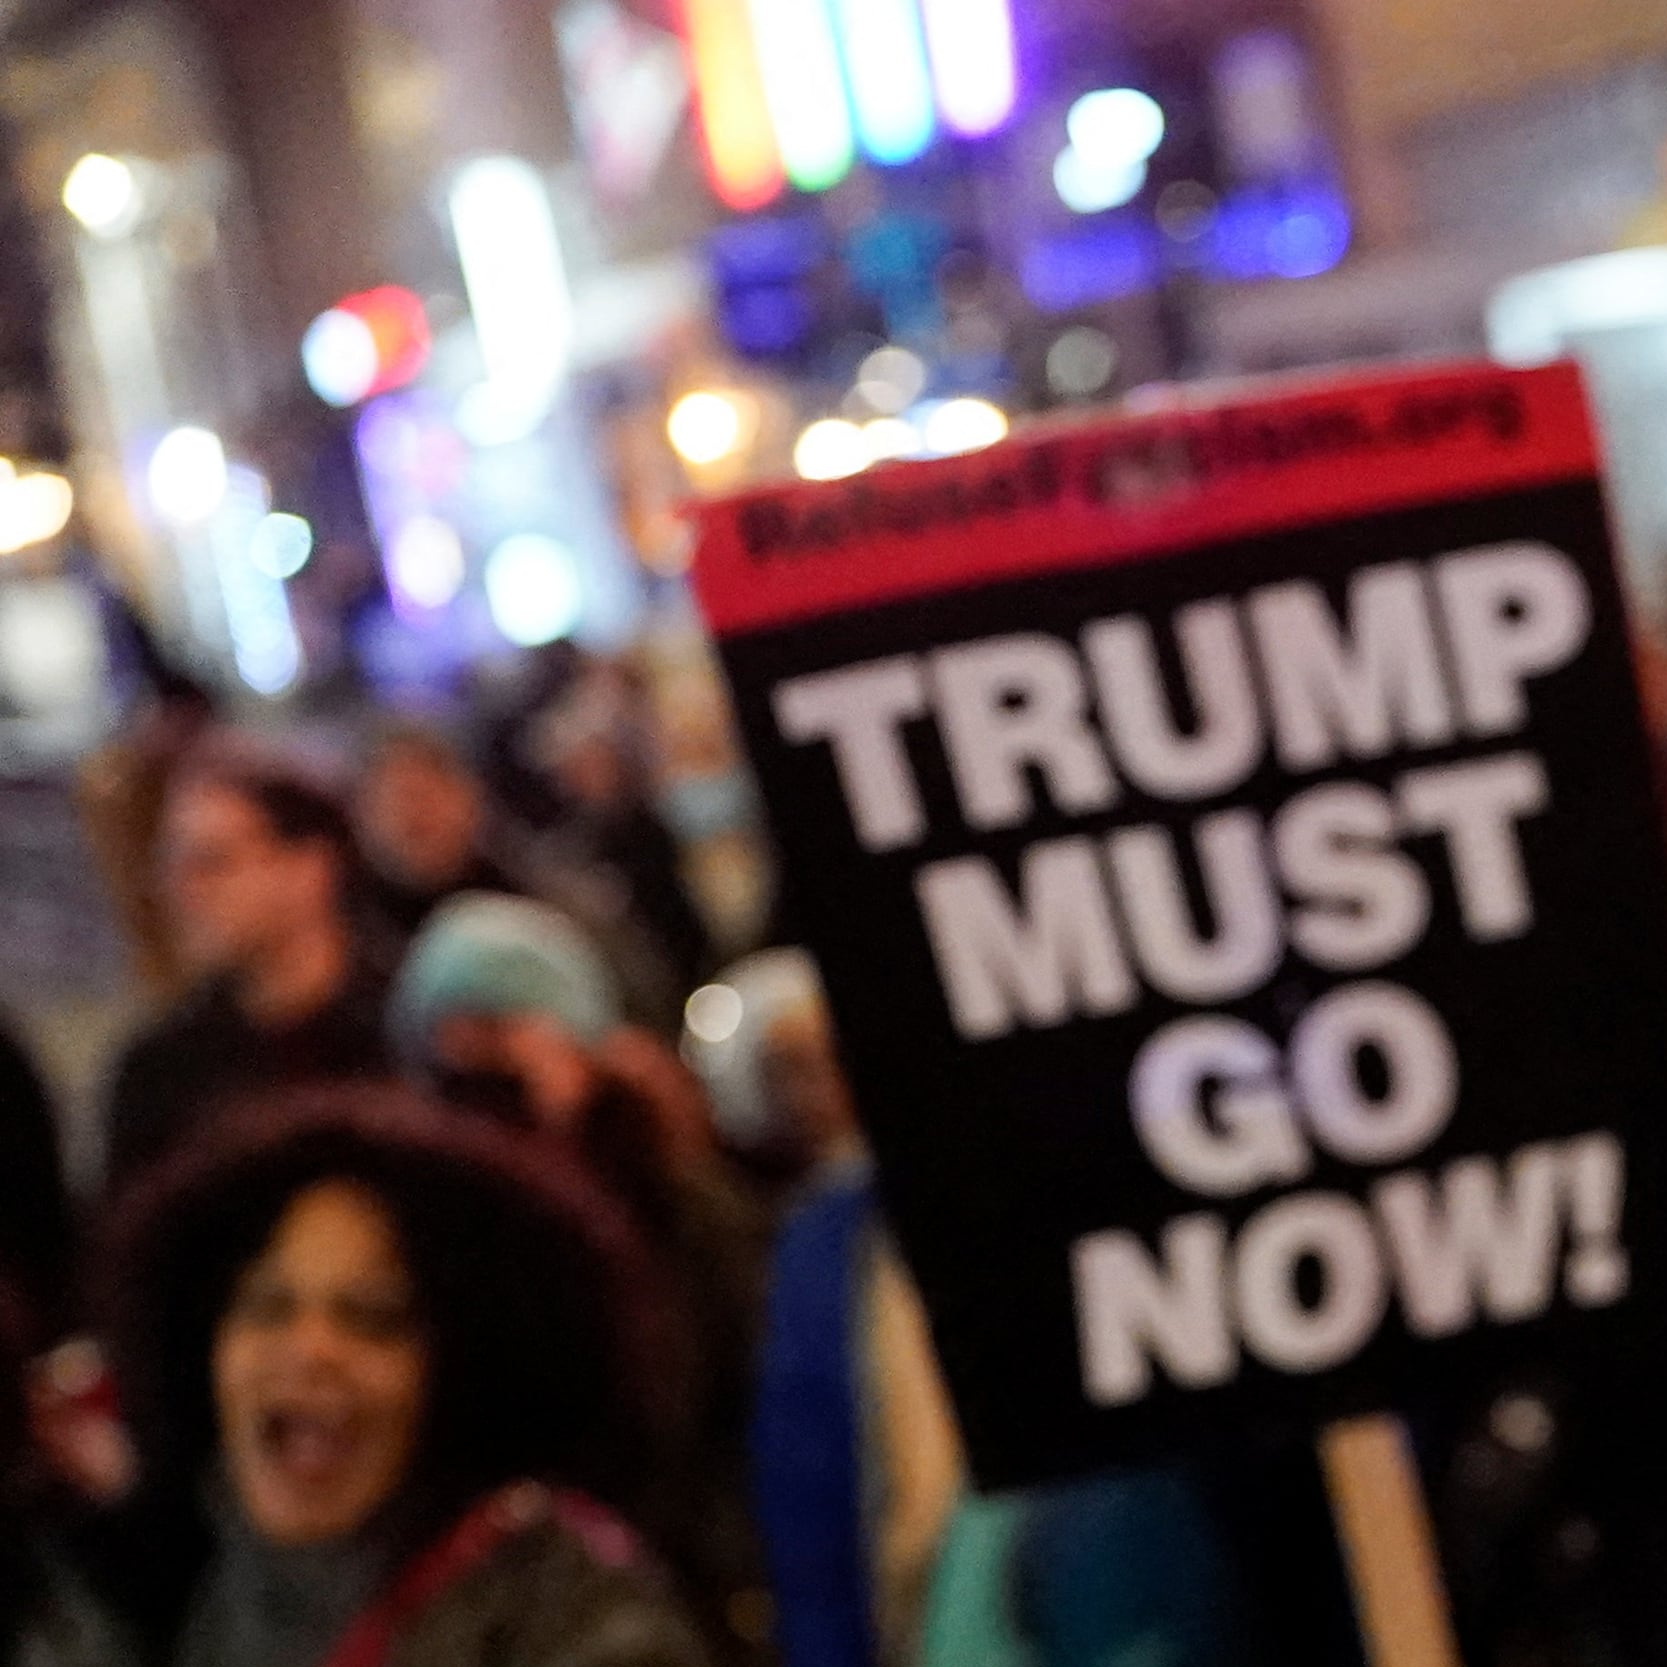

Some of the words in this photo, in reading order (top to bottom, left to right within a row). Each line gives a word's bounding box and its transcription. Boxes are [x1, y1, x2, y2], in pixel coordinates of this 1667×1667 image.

[775, 543, 1590, 852] TRUMP
[915, 755, 1548, 1040] MUST
[1130, 982, 1458, 1198] GO
[1070, 1135, 1630, 1406] NOW!
